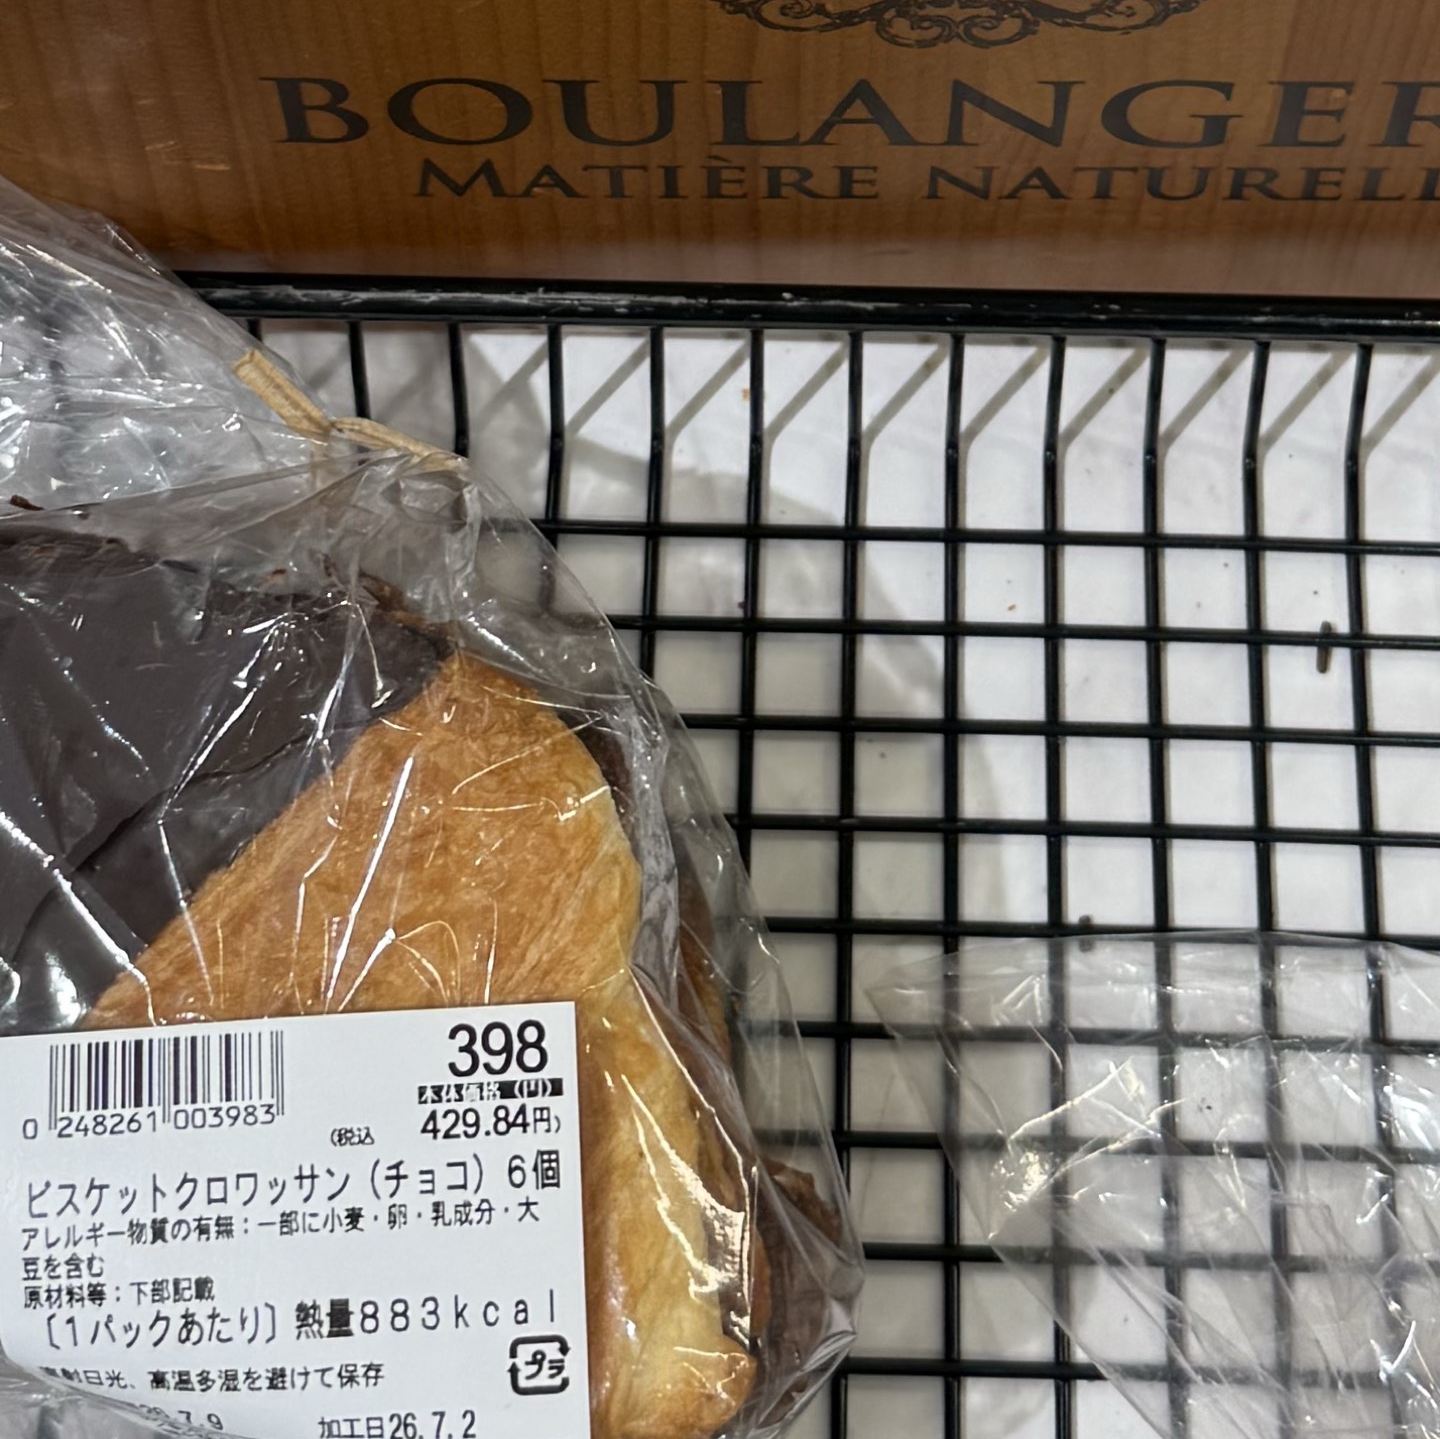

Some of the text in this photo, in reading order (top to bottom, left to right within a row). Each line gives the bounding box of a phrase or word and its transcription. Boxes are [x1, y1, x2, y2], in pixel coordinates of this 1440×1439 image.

[413, 153, 881, 199] MATIÈRE
[447, 1020, 548, 1078] 398
[23, 1103, 278, 1139] 0 248261 003983
[421, 1107, 561, 1141] 429.84円)
[23, 1252, 105, 1281] 豆を含む
